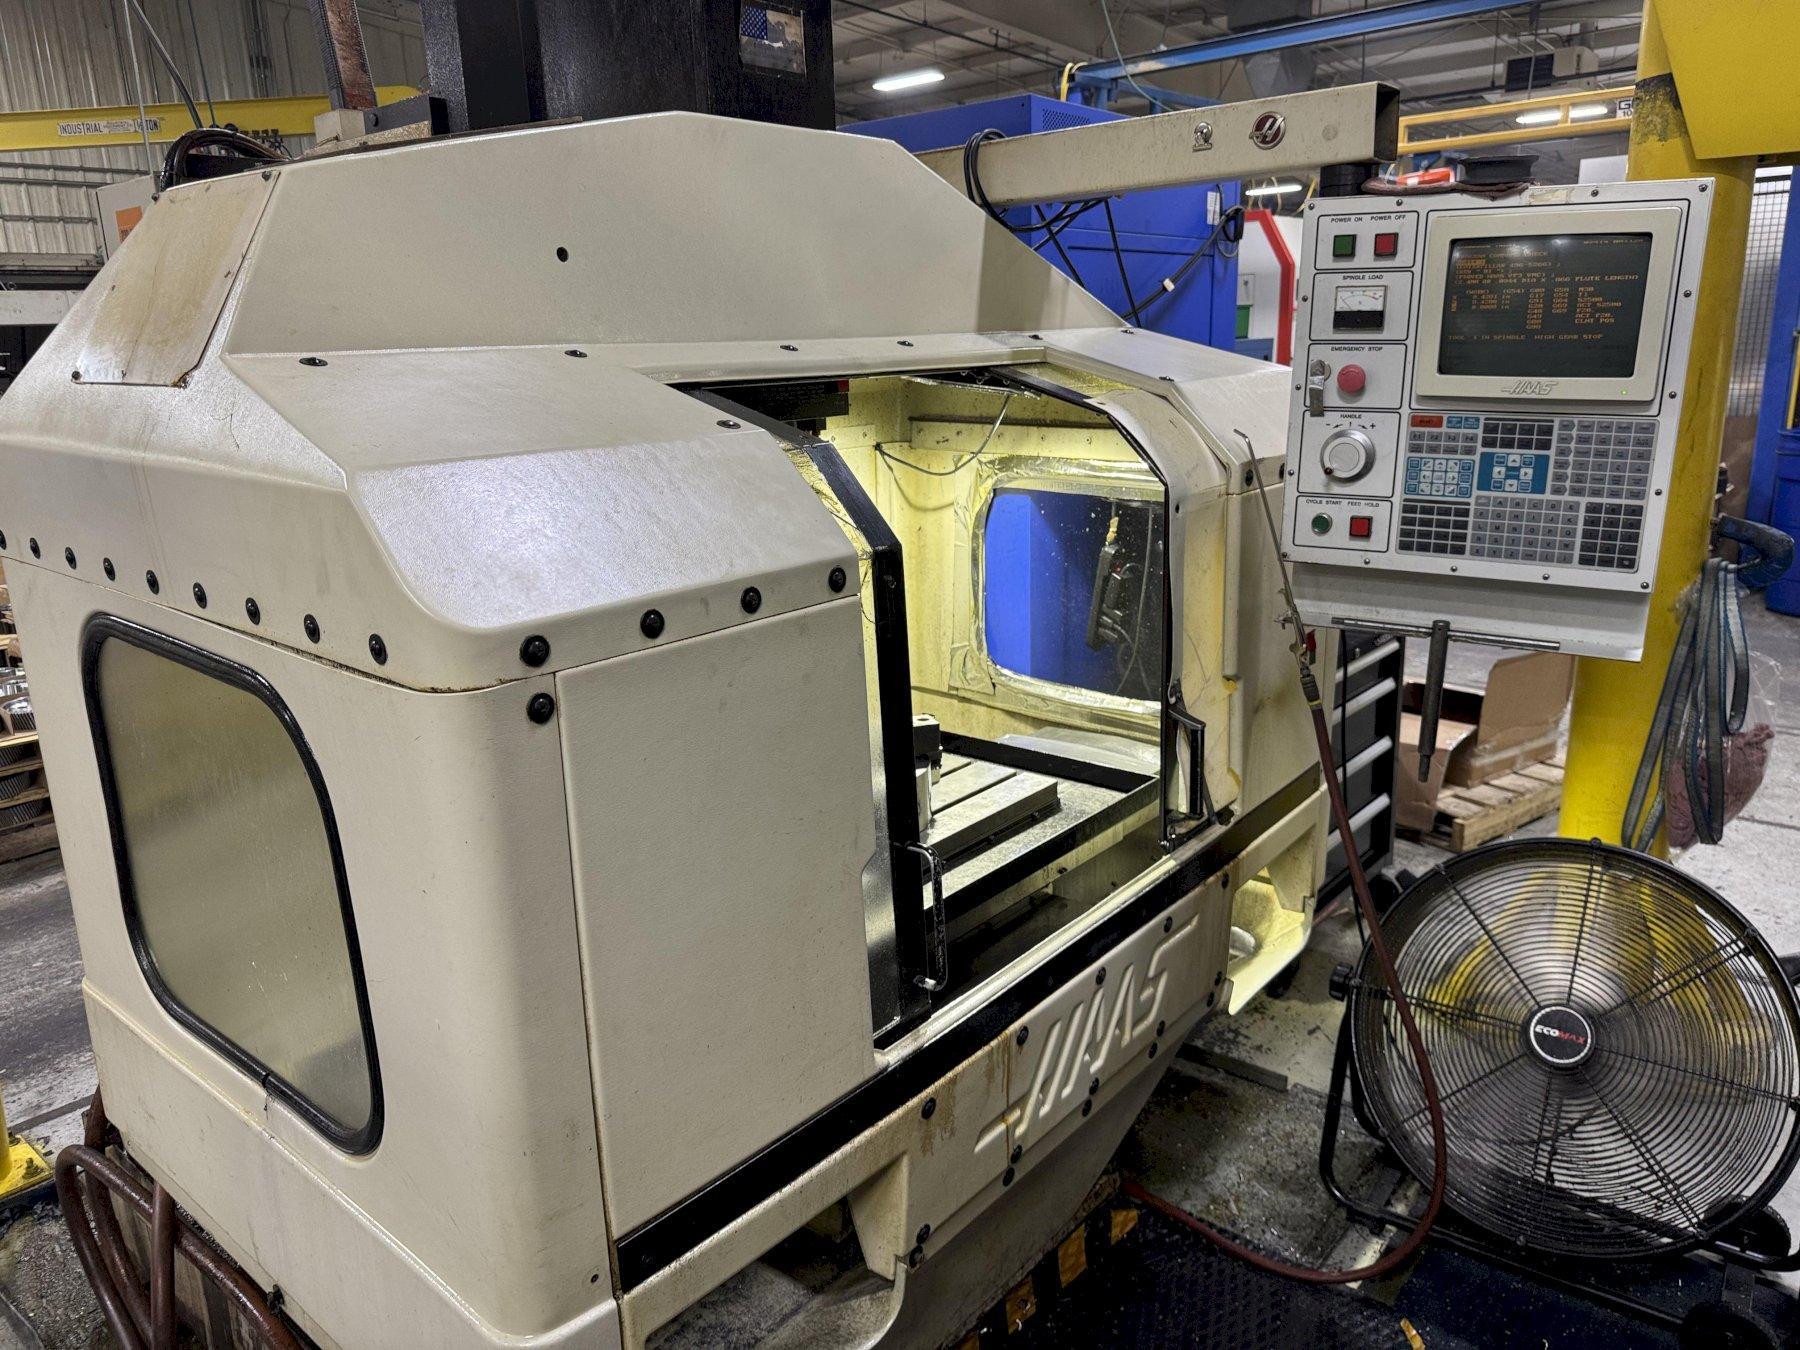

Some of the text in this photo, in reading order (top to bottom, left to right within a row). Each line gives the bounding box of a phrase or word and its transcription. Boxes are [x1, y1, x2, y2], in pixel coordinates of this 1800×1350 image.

[59, 122, 104, 135] INDUSTRIAL
[145, 119, 159, 131] TON
[1501, 379, 1559, 396] HAAS
[974, 914, 1199, 1154] HAAS
[1534, 1024, 1586, 1045] ECOMAX
